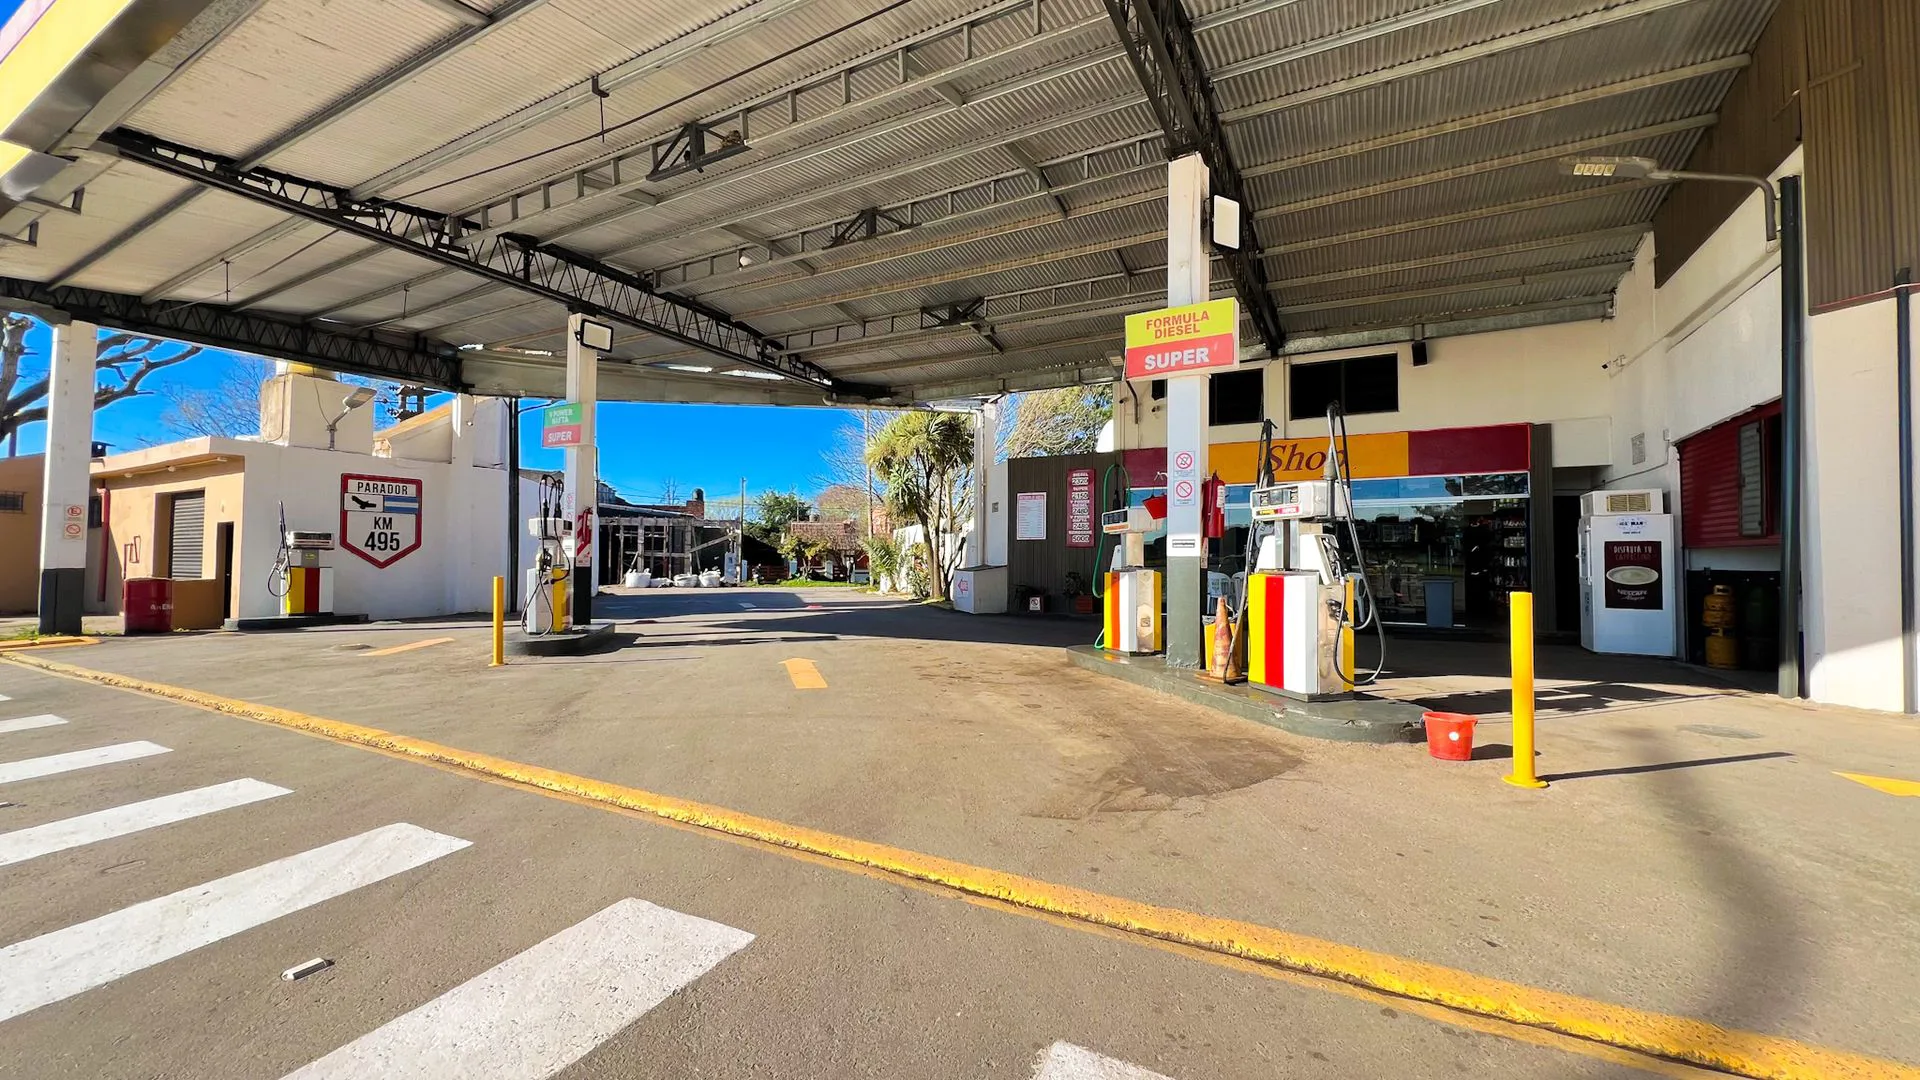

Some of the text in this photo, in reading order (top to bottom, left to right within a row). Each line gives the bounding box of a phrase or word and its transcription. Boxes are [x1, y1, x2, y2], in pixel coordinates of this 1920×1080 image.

[1146, 311, 1209, 330] FORMULA
[1154, 324, 1201, 339] DIESEL
[1144, 347, 1209, 371] SUPER
[548, 431, 572, 442] SUPER
[357, 481, 408, 495] PARADOR
[374, 516, 393, 530] KM
[364, 531, 400, 551] 495
